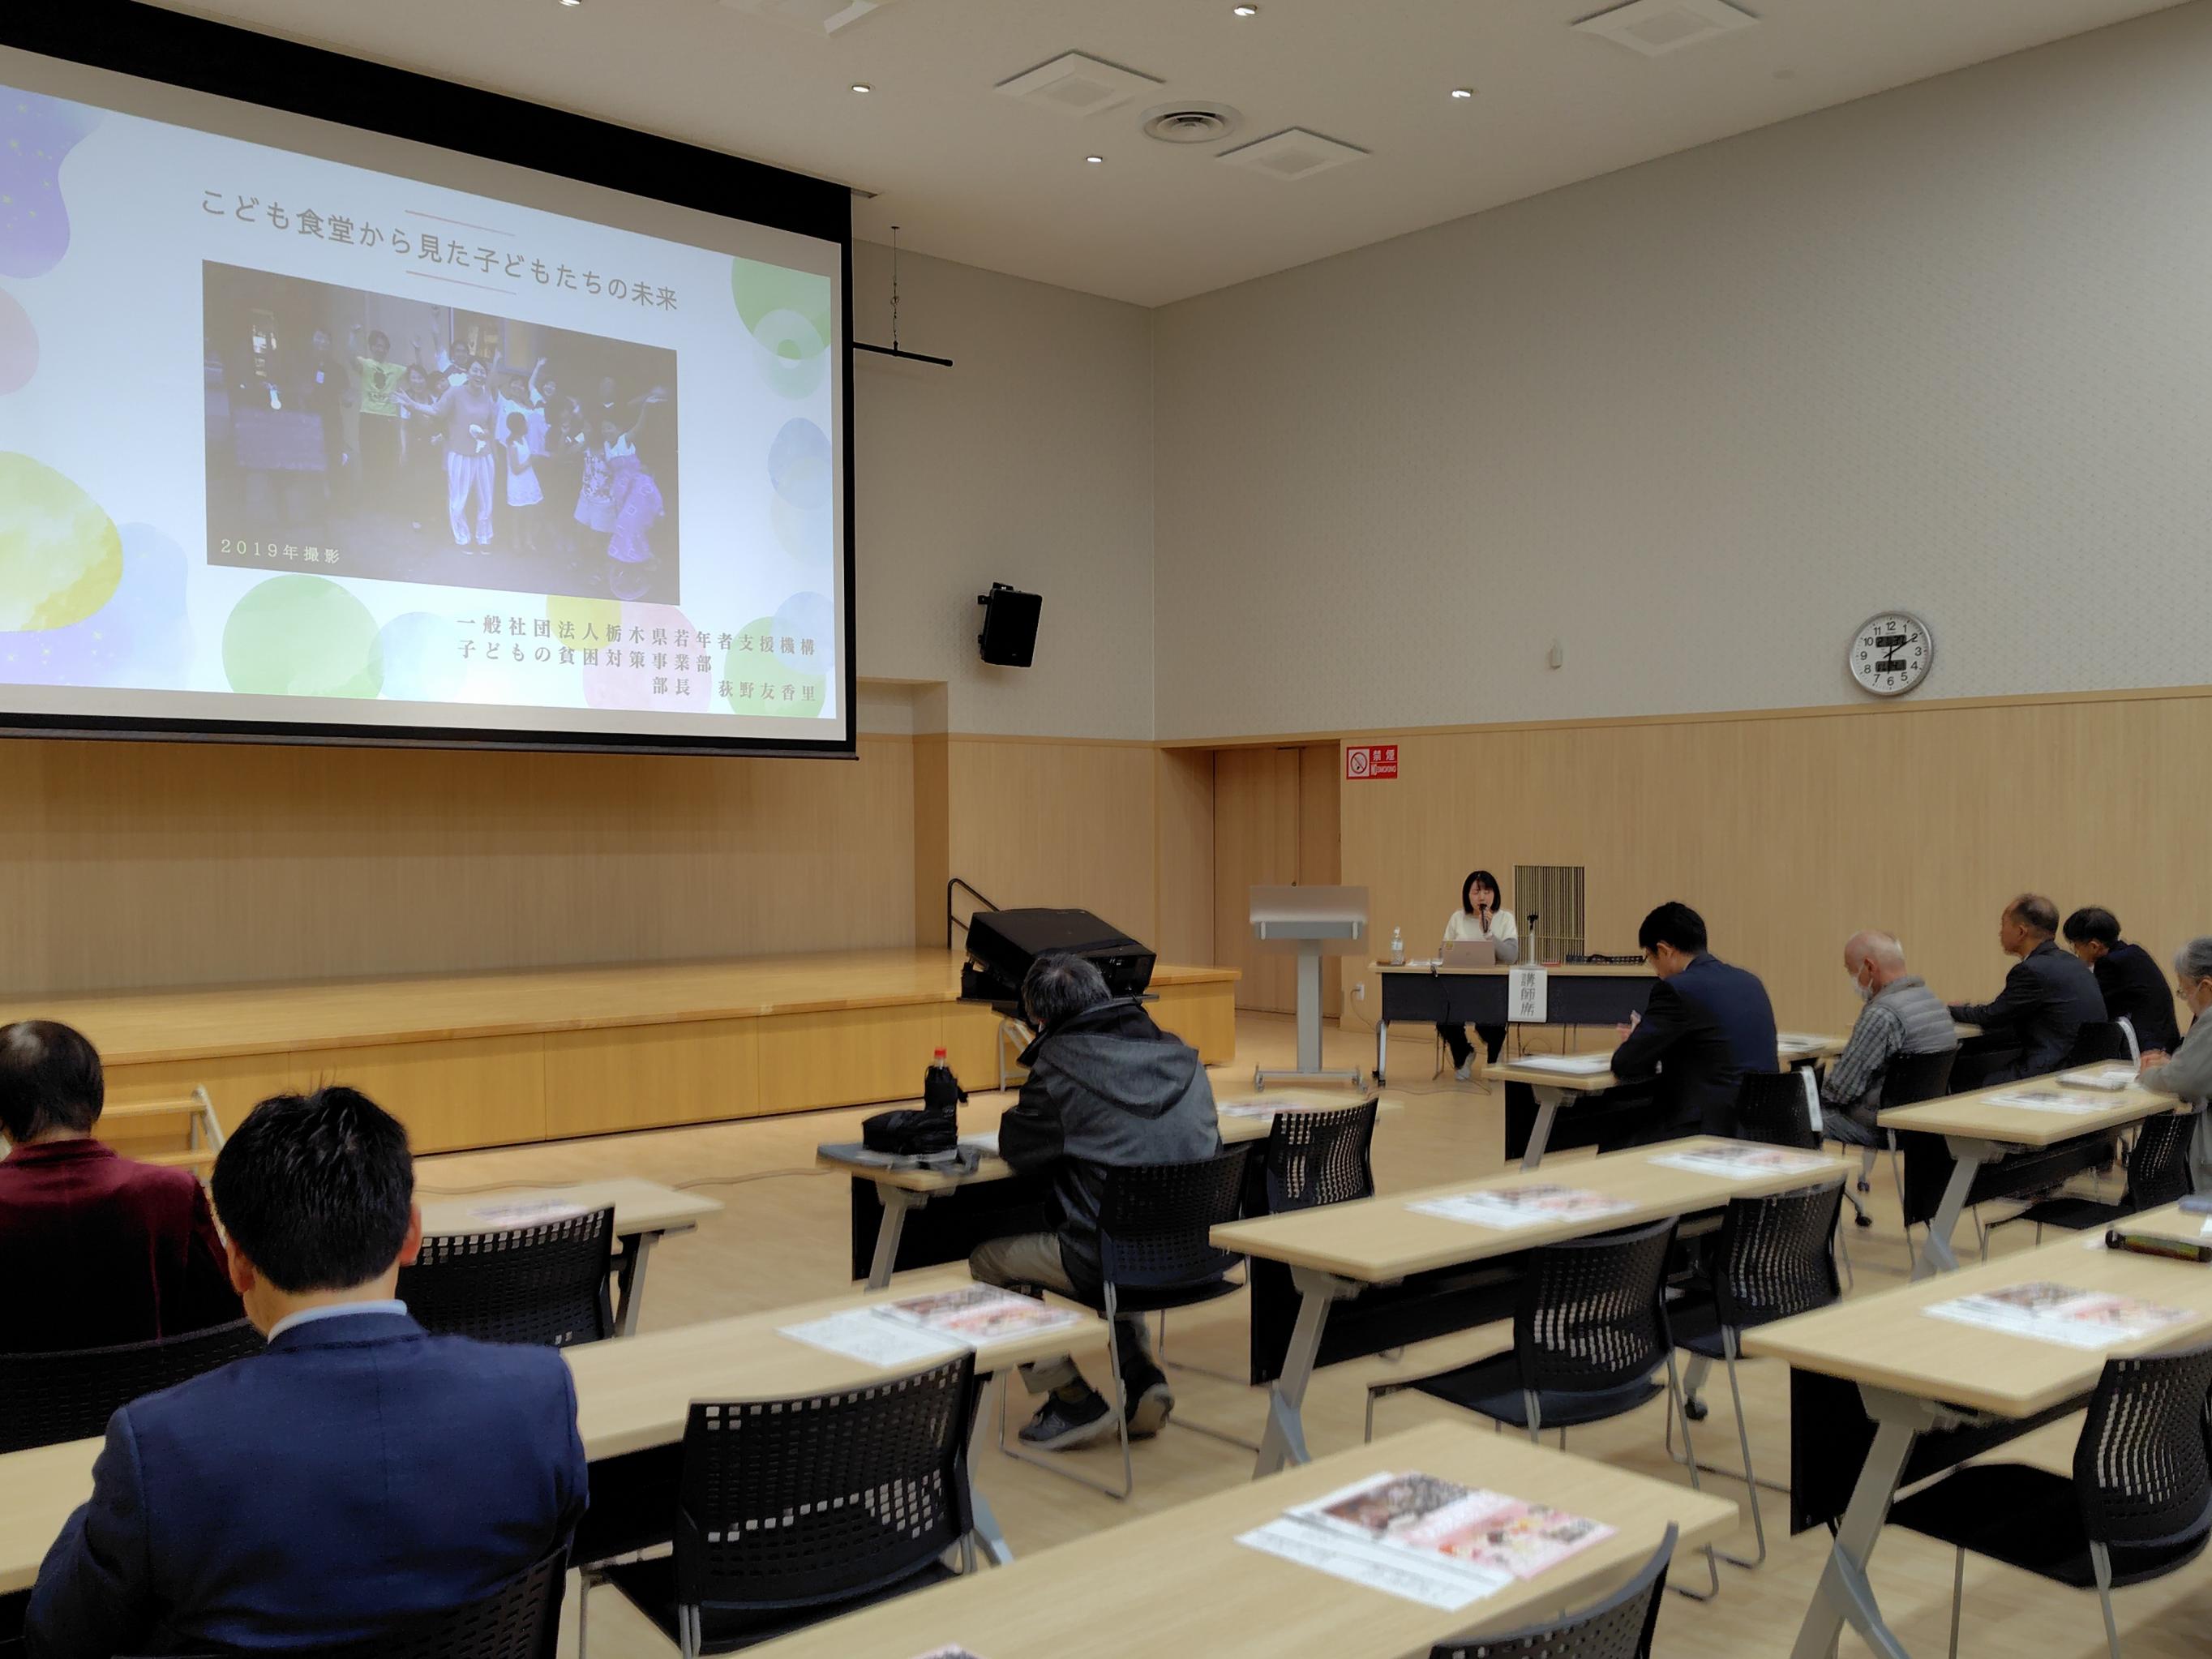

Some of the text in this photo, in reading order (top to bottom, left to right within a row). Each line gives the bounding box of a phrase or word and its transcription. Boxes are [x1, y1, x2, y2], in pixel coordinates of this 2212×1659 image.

[202, 190, 678, 311] こども食堂から見た子どもたちの未来
[221, 538, 340, 565] 2019年撮影
[1873, 626, 1881, 636] 11
[1886, 621, 1896, 631] 12
[1902, 624, 1907, 633] 1
[457, 614, 816, 656] 一般社団法人栃木県若年者支援機構
[1910, 632, 1918, 643] 2
[1863, 637, 1874, 646] 10
[1860, 651, 1867, 660] 9
[1914, 647, 1922, 656] 3
[457, 640, 712, 674] 子どもの貧困対策事業部
[1863, 664, 1871, 674] 8
[1910, 661, 1918, 670] 4
[1874, 674, 1880, 684] 7
[1887, 676, 1894, 686] 6
[1901, 671, 1908, 681] 5
[652, 676, 817, 702] 部長 荻野友香里
